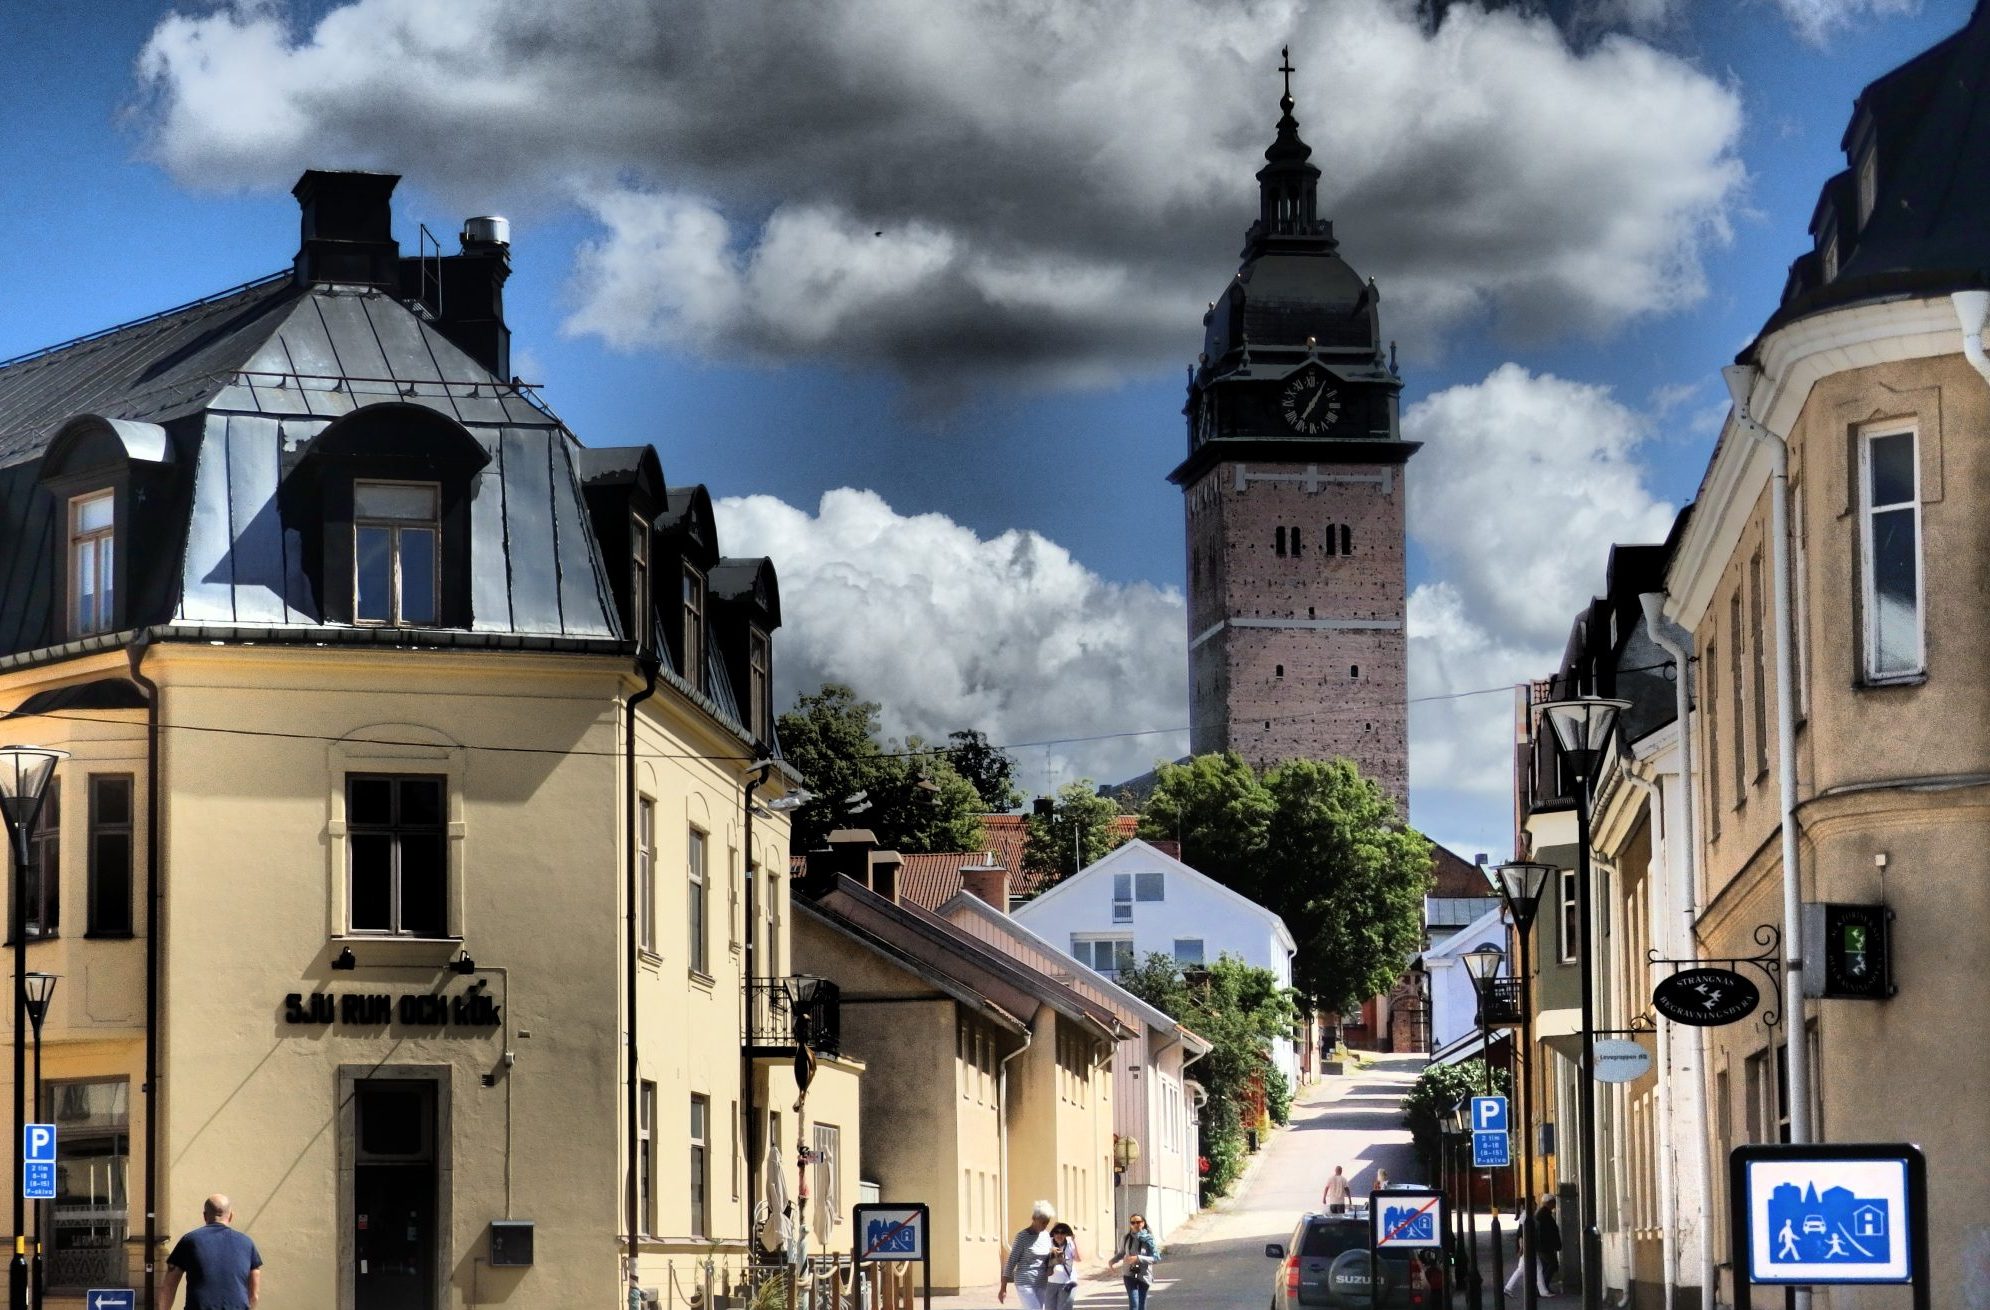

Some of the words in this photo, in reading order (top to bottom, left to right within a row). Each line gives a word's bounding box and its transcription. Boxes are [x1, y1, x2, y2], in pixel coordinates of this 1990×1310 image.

[286, 993, 335, 1025] SJU
[341, 994, 391, 1025] RUM
[400, 994, 448, 1025] OCH
[1480, 1100, 1500, 1128] P
[32, 1128, 50, 1158] P
[38, 1164, 48, 1172] tim
[1336, 1275, 1385, 1285] SUZUI
